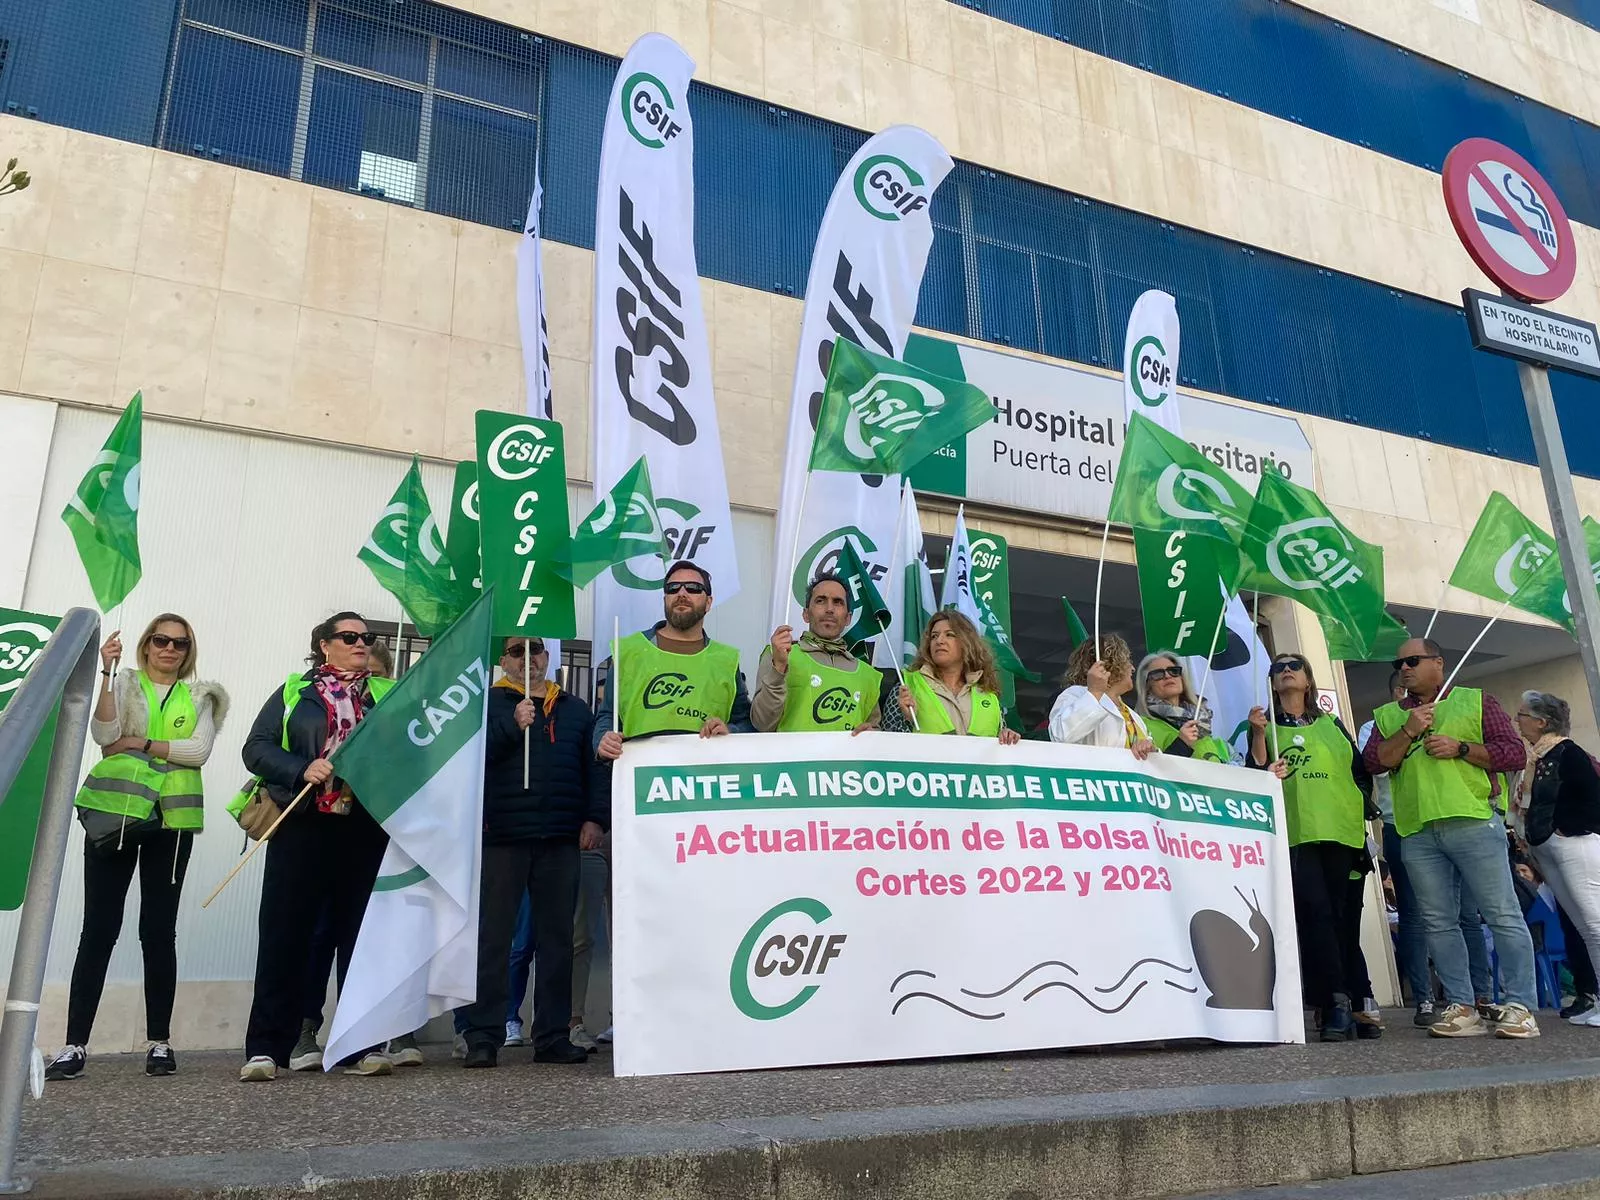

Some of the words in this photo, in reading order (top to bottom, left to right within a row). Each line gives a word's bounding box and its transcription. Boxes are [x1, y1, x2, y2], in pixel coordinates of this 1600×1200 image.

[634, 91, 682, 140] CSIF
[869, 170, 928, 215] CSIF
[615, 184, 697, 446] CSIF
[1483, 306, 1498, 319] EN
[1501, 311, 1530, 328] TODO
[1534, 320, 1546, 333] EL
[1548, 324, 1591, 345] RECINTO
[1505, 327, 1578, 356] HOSPITALARIO
[993, 396, 1115, 446] Hospital
[501, 439, 554, 464] CSIF
[993, 440, 1071, 476] Puerta
[1078, 456, 1113, 484] del
[971, 550, 1001, 570] CSIF
[1284, 538, 1363, 589] CSIF
[646, 774, 742, 803] ANTE
[753, 772, 798, 798] LA
[808, 770, 1044, 799] INSOPORTABLE
[1050, 777, 1171, 810] LENTITUD
[1177, 790, 1222, 817] DEL
[1227, 798, 1273, 828] SAS,
[675, 820, 951, 864] ¡Actualización
[961, 822, 1005, 852] de
[1016, 821, 1050, 850] la
[1058, 821, 1150, 850] Bolsa
[1153, 821, 1222, 861] Única
[1228, 840, 1266, 868] ya!
[855, 866, 967, 896] Cortes
[977, 865, 1067, 894] 2022
[1074, 871, 1092, 896] y
[1101, 864, 1173, 892] 2023
[754, 934, 848, 977] CSIF
